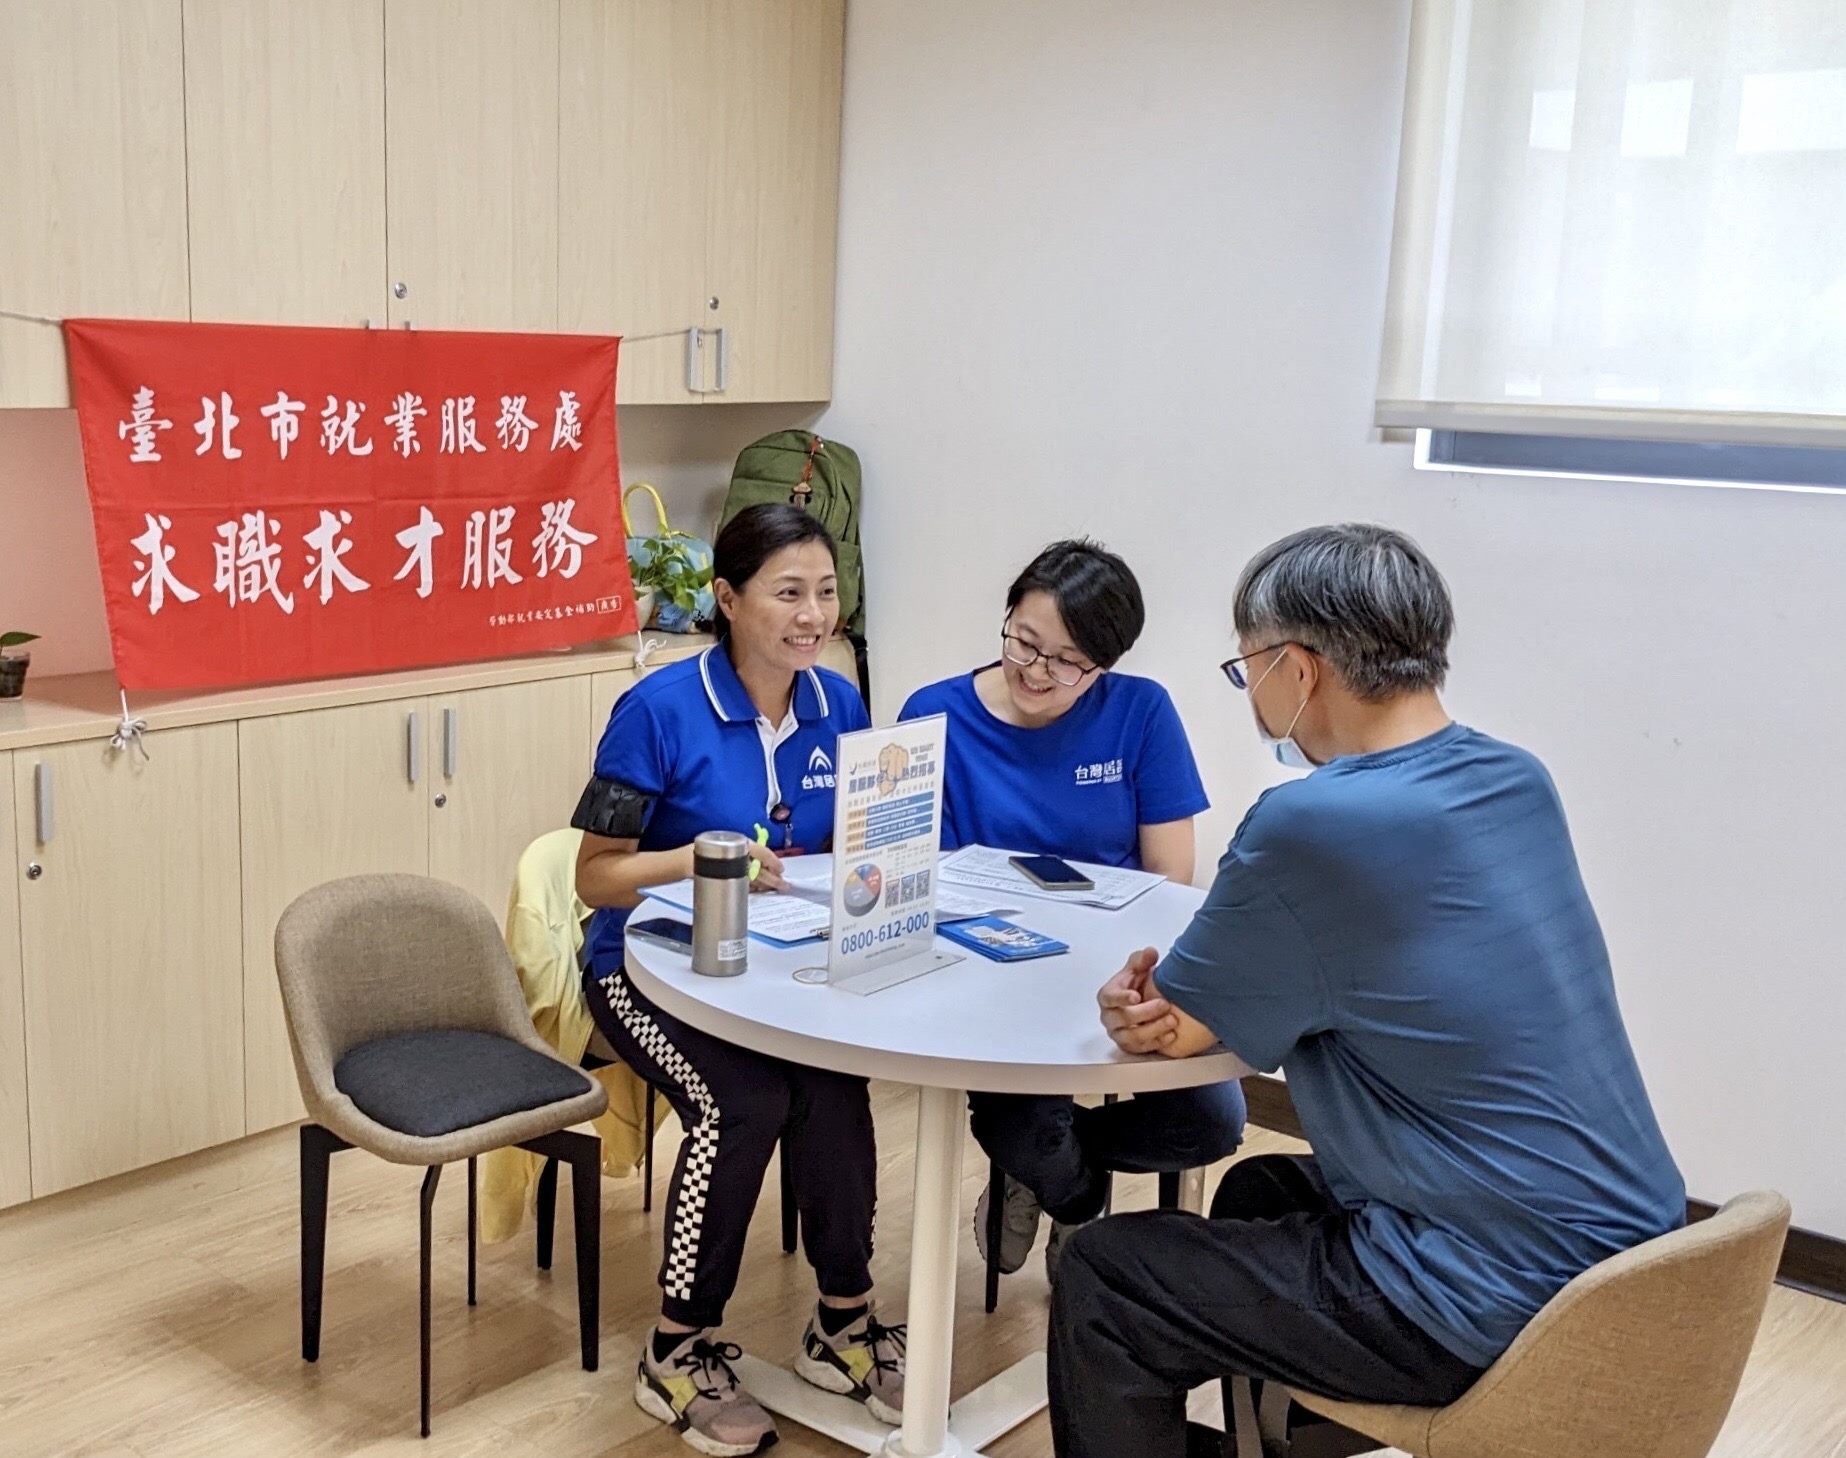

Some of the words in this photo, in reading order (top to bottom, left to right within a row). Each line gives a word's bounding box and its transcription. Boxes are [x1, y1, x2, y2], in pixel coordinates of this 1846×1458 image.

[118, 385, 583, 463] 臺北市就業服務處
[130, 497, 599, 616] 求職求才服務
[801, 774, 838, 790] 台灣居
[841, 911, 930, 955] 0800-612-000
